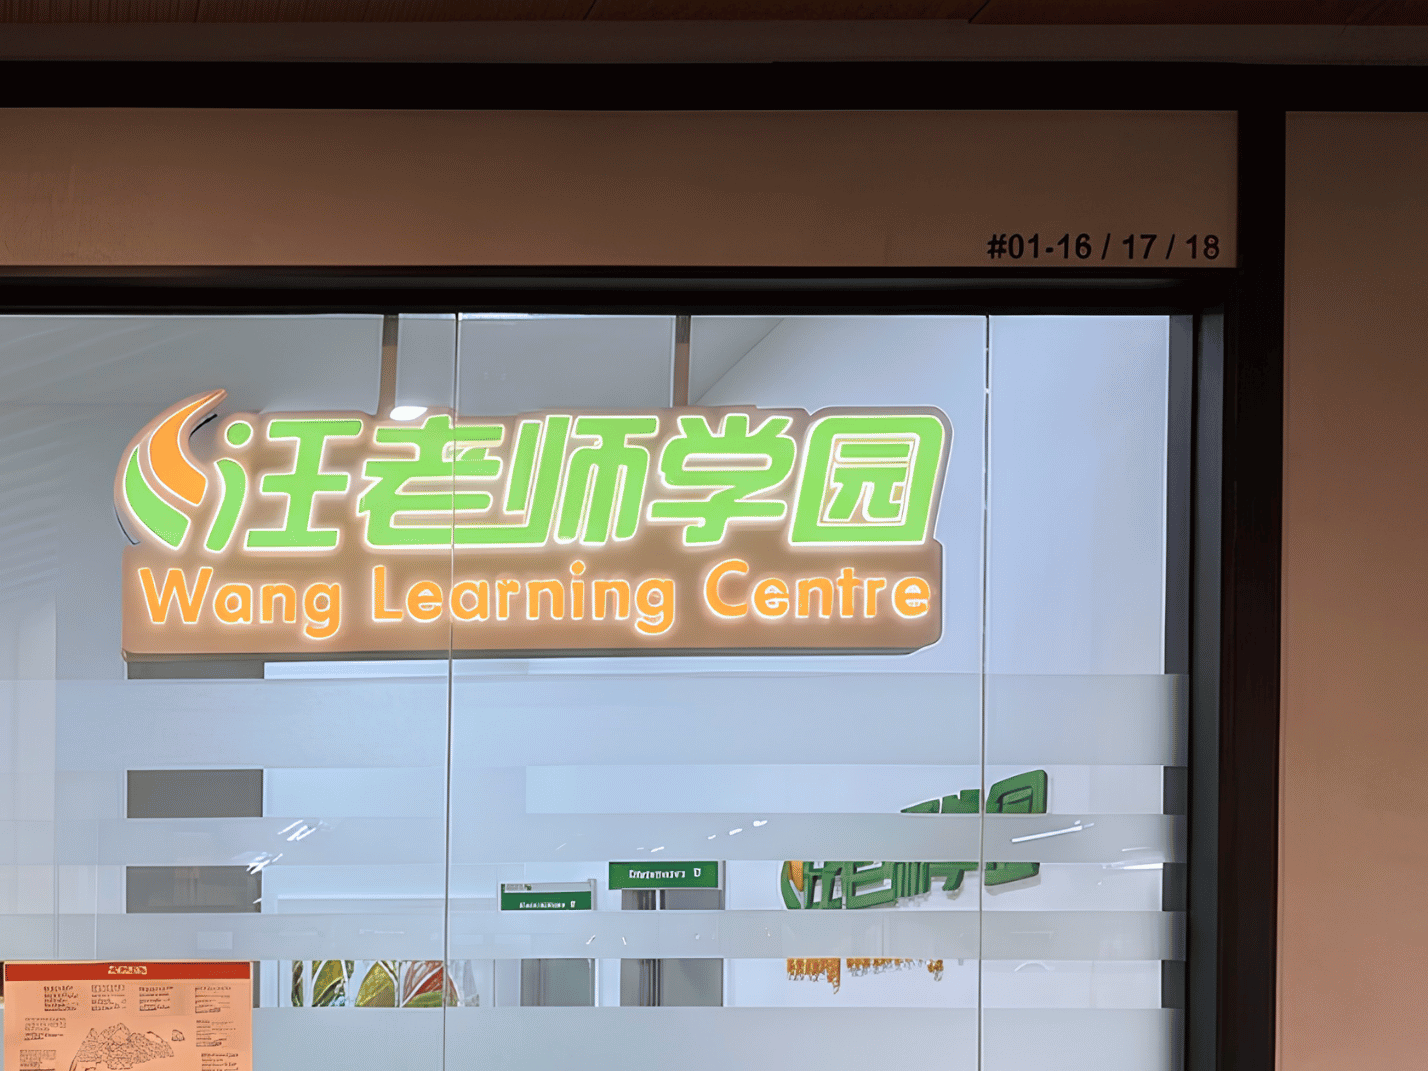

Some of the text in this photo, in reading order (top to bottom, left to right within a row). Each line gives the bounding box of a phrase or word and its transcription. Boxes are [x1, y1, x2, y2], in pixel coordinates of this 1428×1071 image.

[987, 233, 1220, 260] #01-16 / 17 / 18
[204, 414, 946, 552] 汪老师学园
[138, 558, 932, 640] Wang Learning Centre
